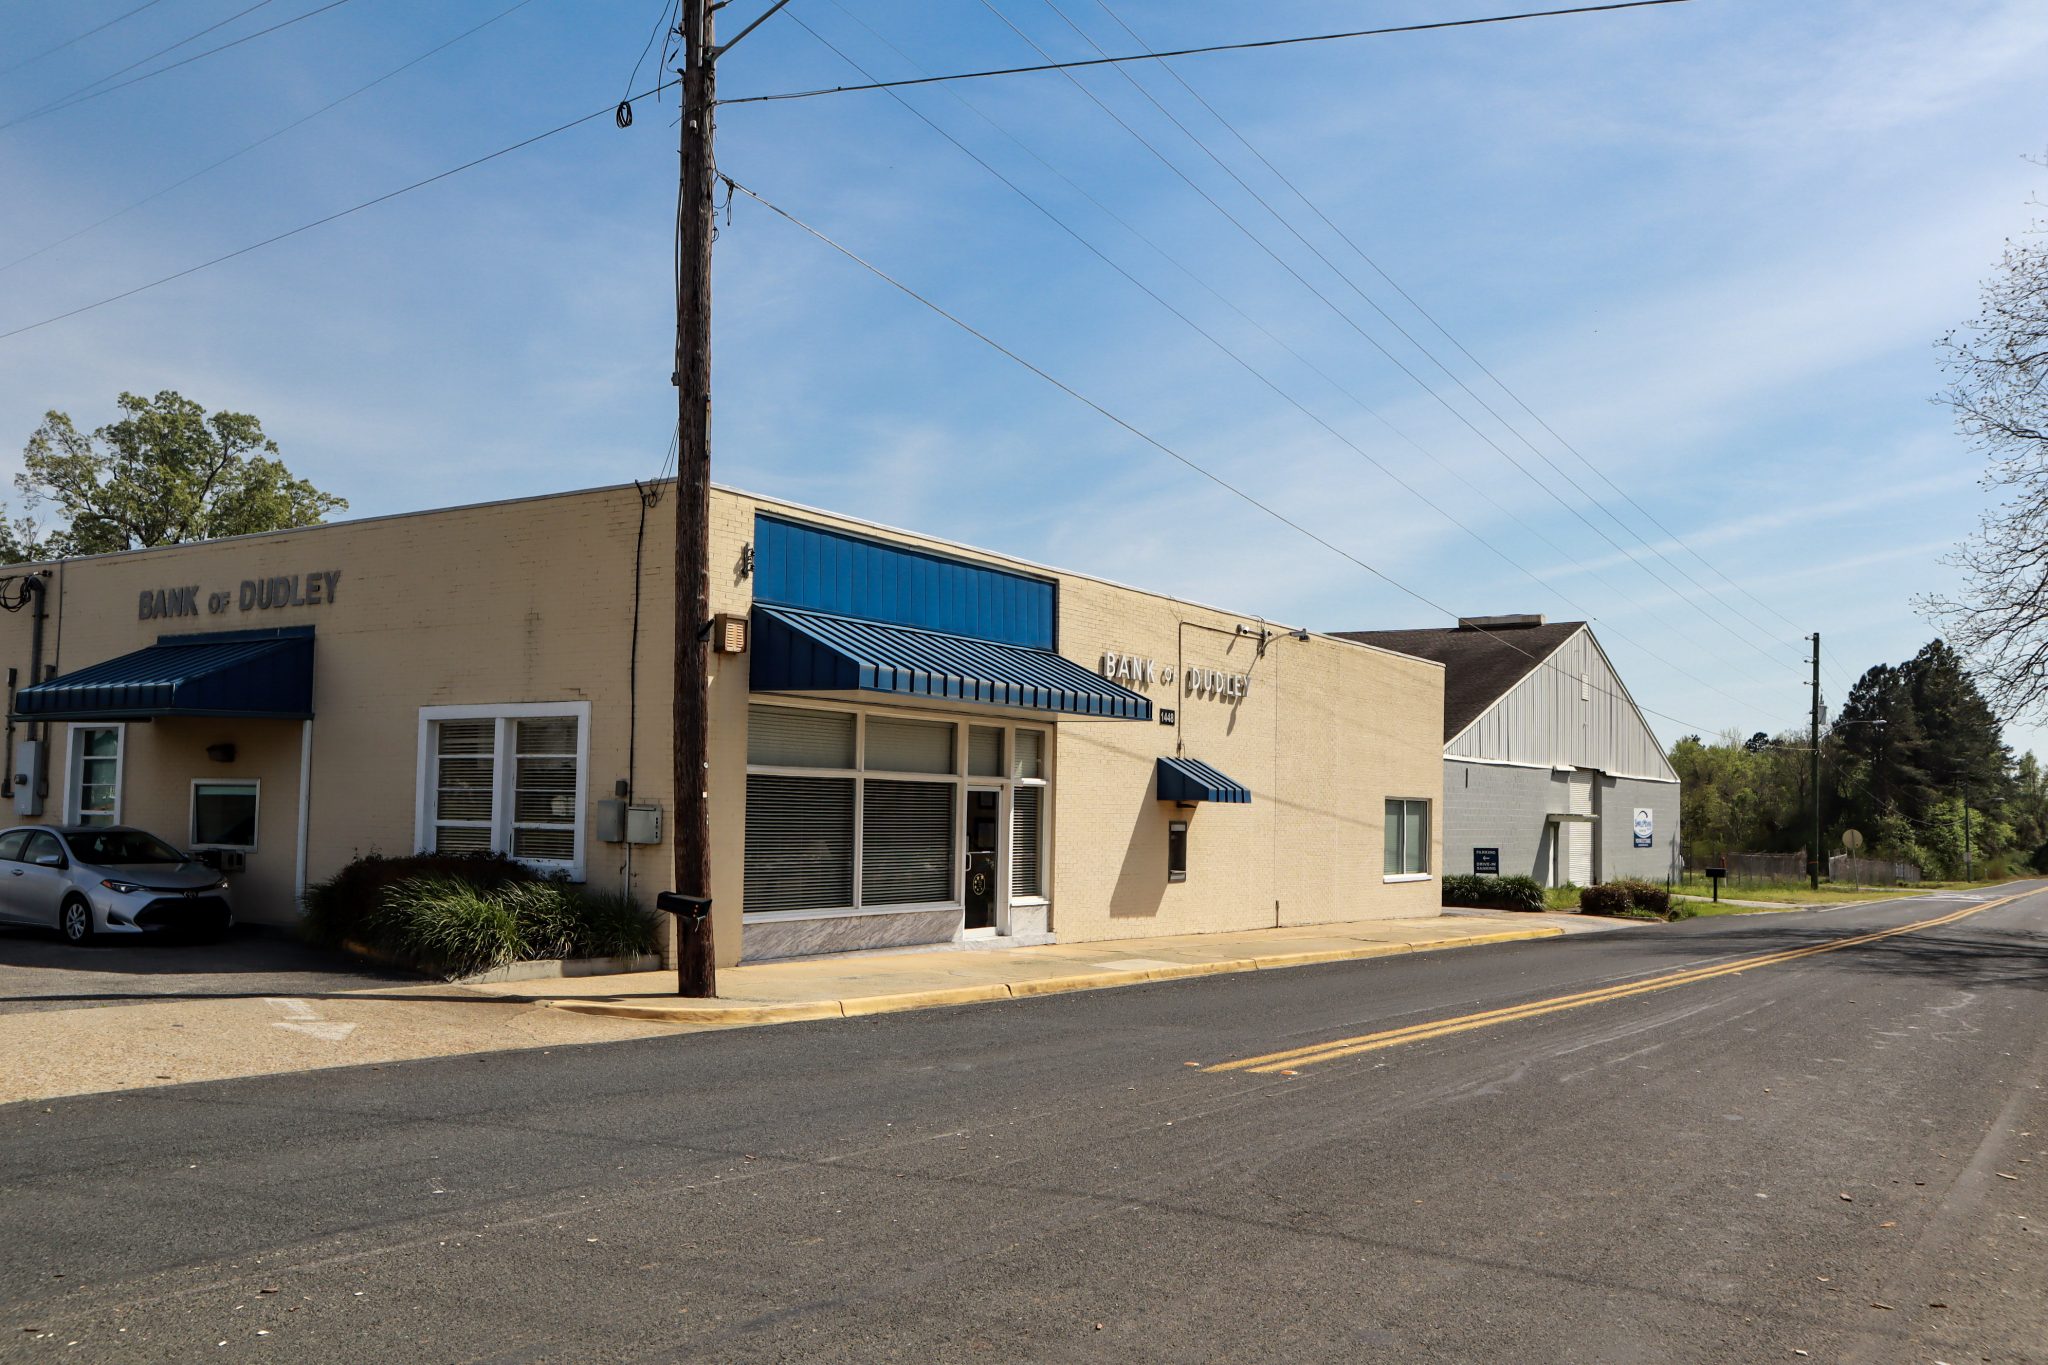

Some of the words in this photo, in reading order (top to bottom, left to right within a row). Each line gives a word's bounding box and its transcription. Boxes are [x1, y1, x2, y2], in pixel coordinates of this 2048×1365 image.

[138, 585, 199, 620] BANK
[207, 591, 231, 614] OF
[239, 570, 341, 611] DUDLEY
[1103, 651, 1155, 683] BANK
[1190, 667, 1250, 697] DUDLEY
[1161, 711, 1174, 723] 1448
